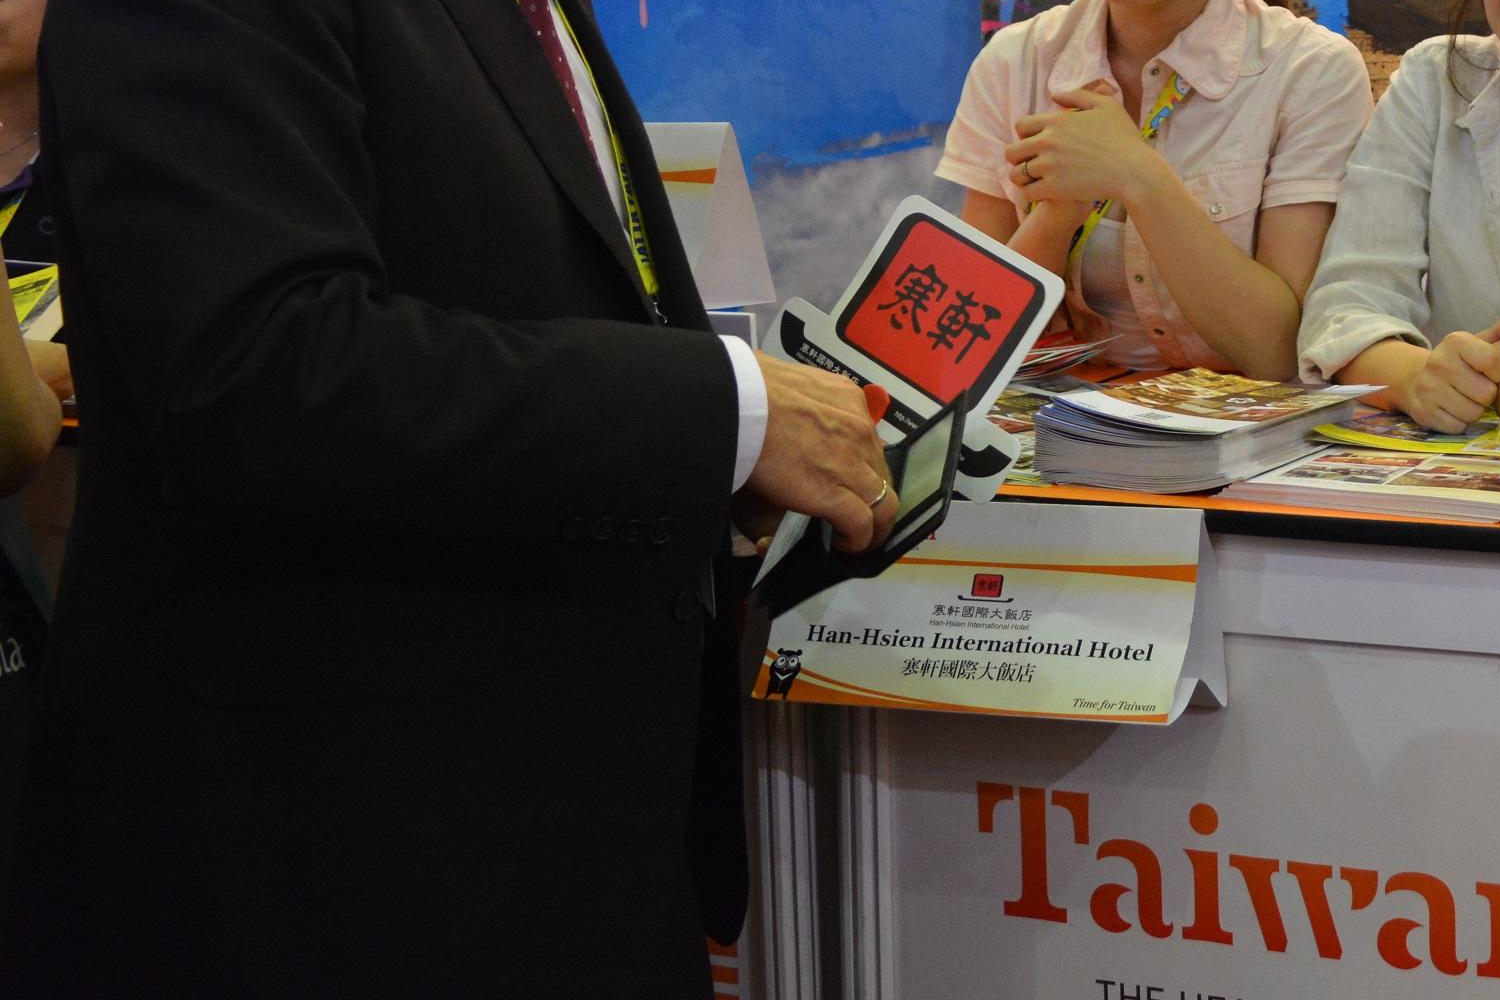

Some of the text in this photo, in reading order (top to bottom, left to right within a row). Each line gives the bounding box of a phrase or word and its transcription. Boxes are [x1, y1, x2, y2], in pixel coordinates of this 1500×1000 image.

[929, 619, 1030, 631] Han-Hsien International Hotel
[806, 623, 1154, 663] Han-Hsien International Hotel
[902, 656, 1037, 684] 寒軒國際大飯店
[1072, 697, 1157, 712] Time for Taiwan
